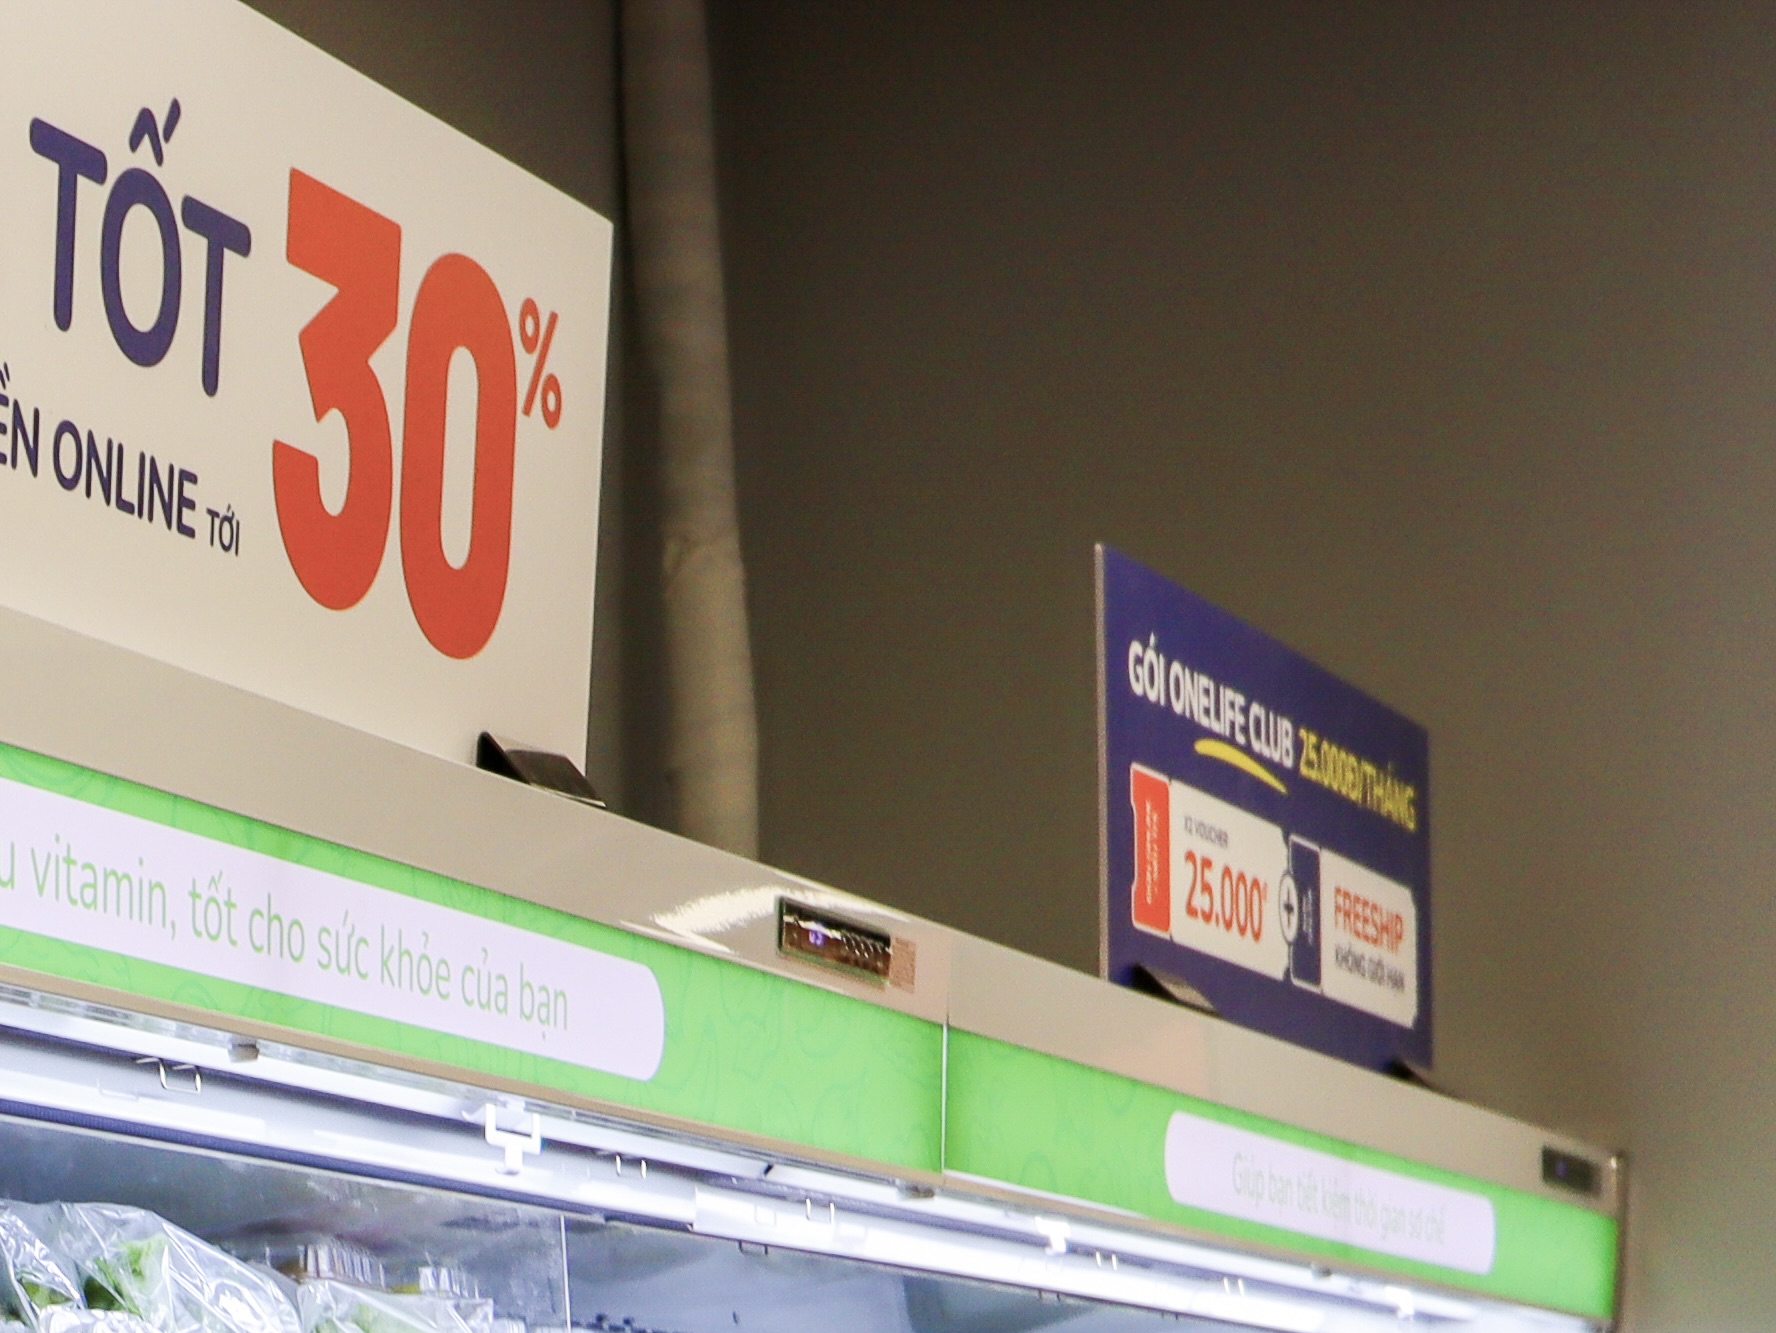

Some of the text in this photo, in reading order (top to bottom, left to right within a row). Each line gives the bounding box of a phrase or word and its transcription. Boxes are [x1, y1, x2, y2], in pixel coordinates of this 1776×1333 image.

[29, 97, 251, 397] TỐT
[52, 418, 198, 538] ONLINE
[1128, 632, 1166, 706] GÓI
[1169, 659, 1246, 747] ONELIFE
[1249, 702, 1296, 768] CLUB
[30, 840, 178, 943] vitamin,
[188, 874, 238, 949] tốt
[247, 899, 307, 964] cho
[316, 907, 370, 982] sức
[380, 929, 452, 998] khỏe
[459, 946, 510, 1013] của
[519, 962, 569, 1042] bạn
[1333, 885, 1404, 954] FREESHIP
